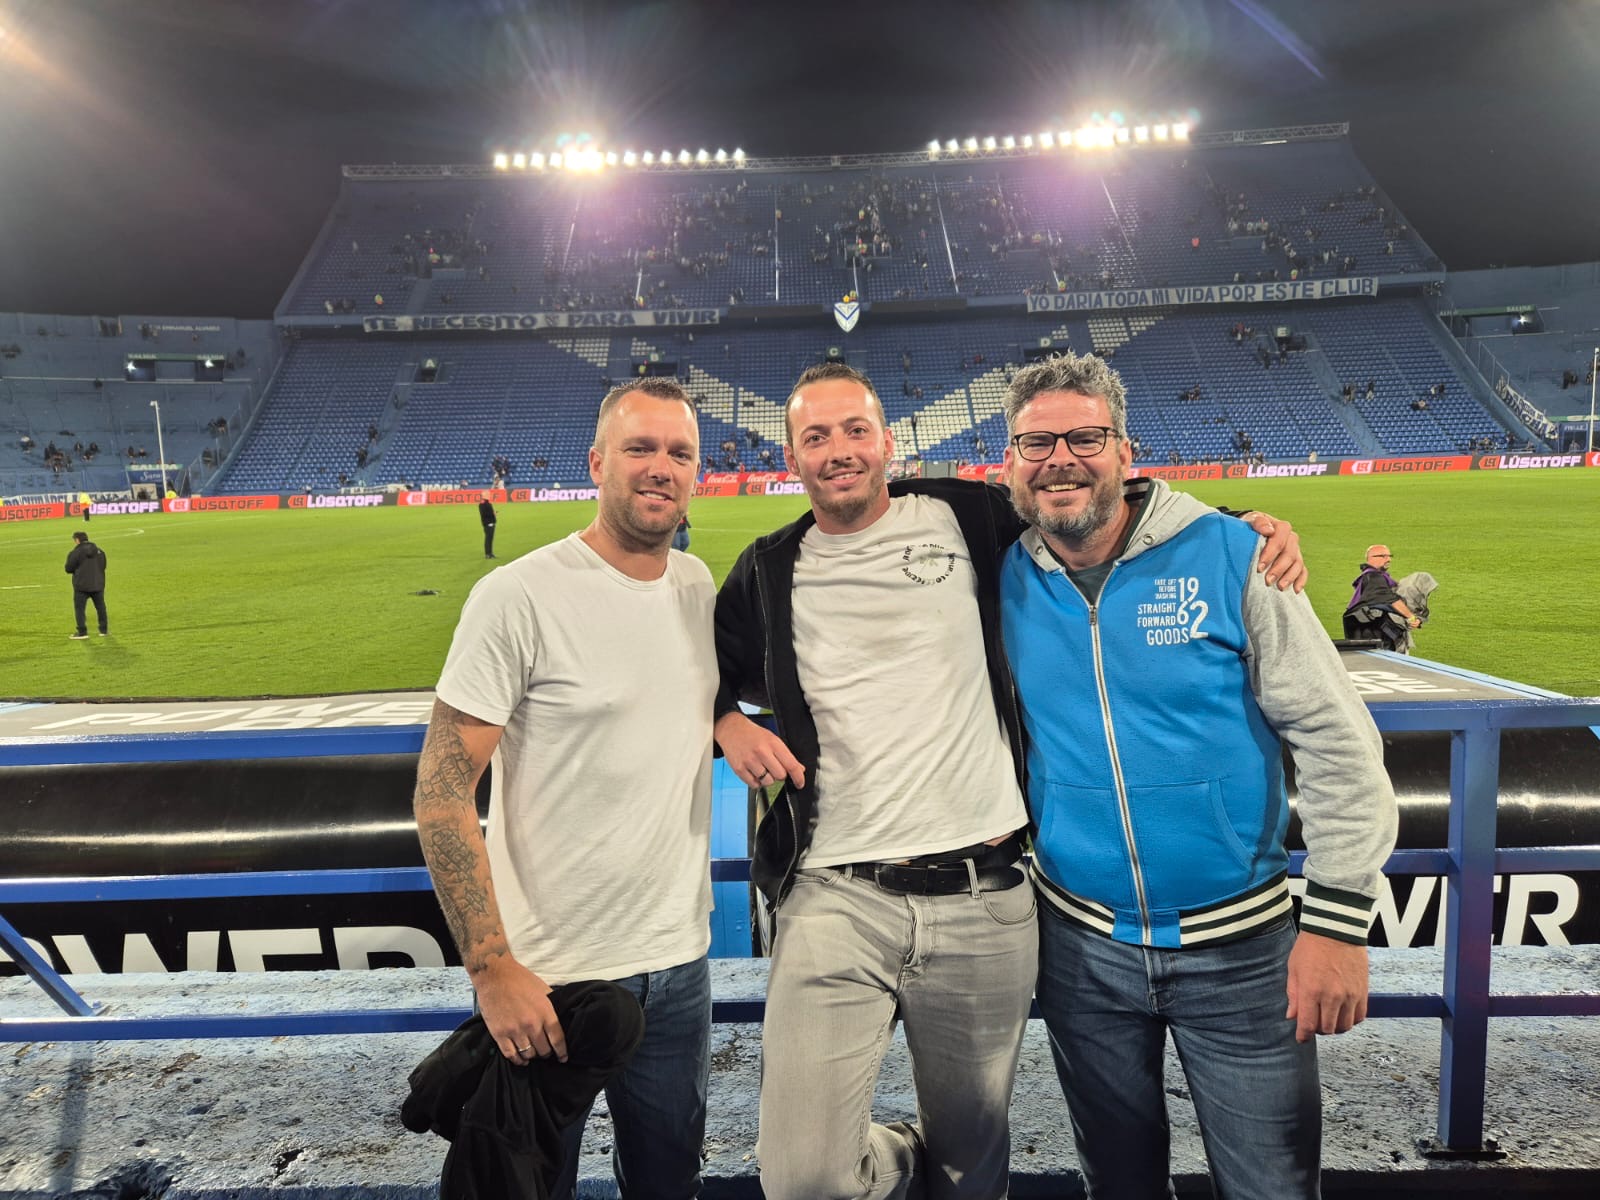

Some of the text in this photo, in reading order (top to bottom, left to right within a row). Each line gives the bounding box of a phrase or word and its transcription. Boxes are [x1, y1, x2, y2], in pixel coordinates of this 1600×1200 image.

[1030, 278, 1373, 310] YO DARIA TODA MI VIDA POR ESTE CLUB
[365, 309, 717, 330] TE NECESITO PARA VIVIR
[829, 347, 839, 356] C
[426, 359, 435, 368] A
[1178, 577, 1200, 602] 19
[1137, 602, 1177, 614] STRAIGHT
[1137, 616, 1176, 628] FORWARD
[1177, 600, 1209, 639] 62
[1146, 627, 1190, 646] GOODS
